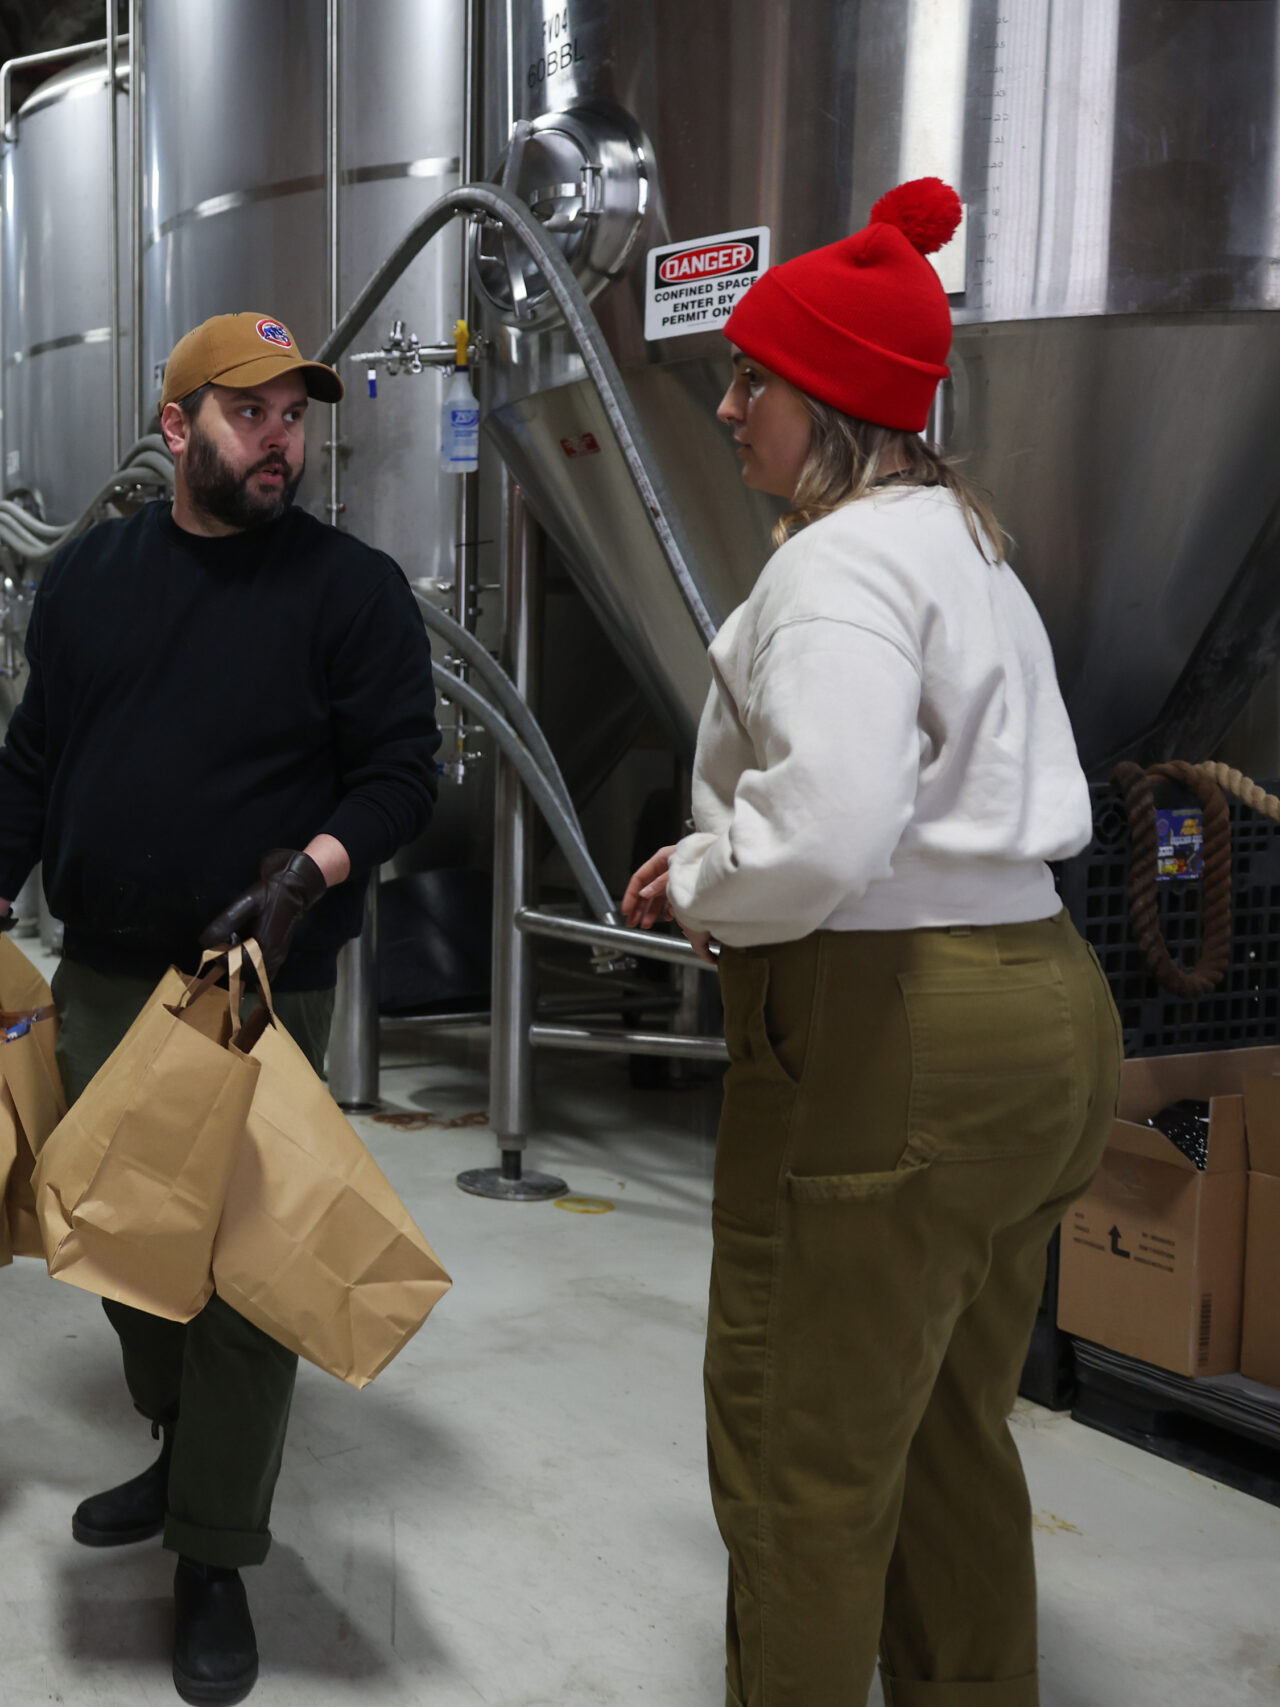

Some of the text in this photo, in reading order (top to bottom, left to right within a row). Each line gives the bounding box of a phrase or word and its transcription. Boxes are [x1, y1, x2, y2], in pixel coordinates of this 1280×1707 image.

[527, 38, 585, 89] 60BBL
[665, 246, 748, 279] DANGER
[654, 275, 758, 303] CONFINED SPACE
[673, 293, 735, 313] ENTER BY
[662, 309, 709, 327] PERMIT
[712, 305, 736, 318] ON
